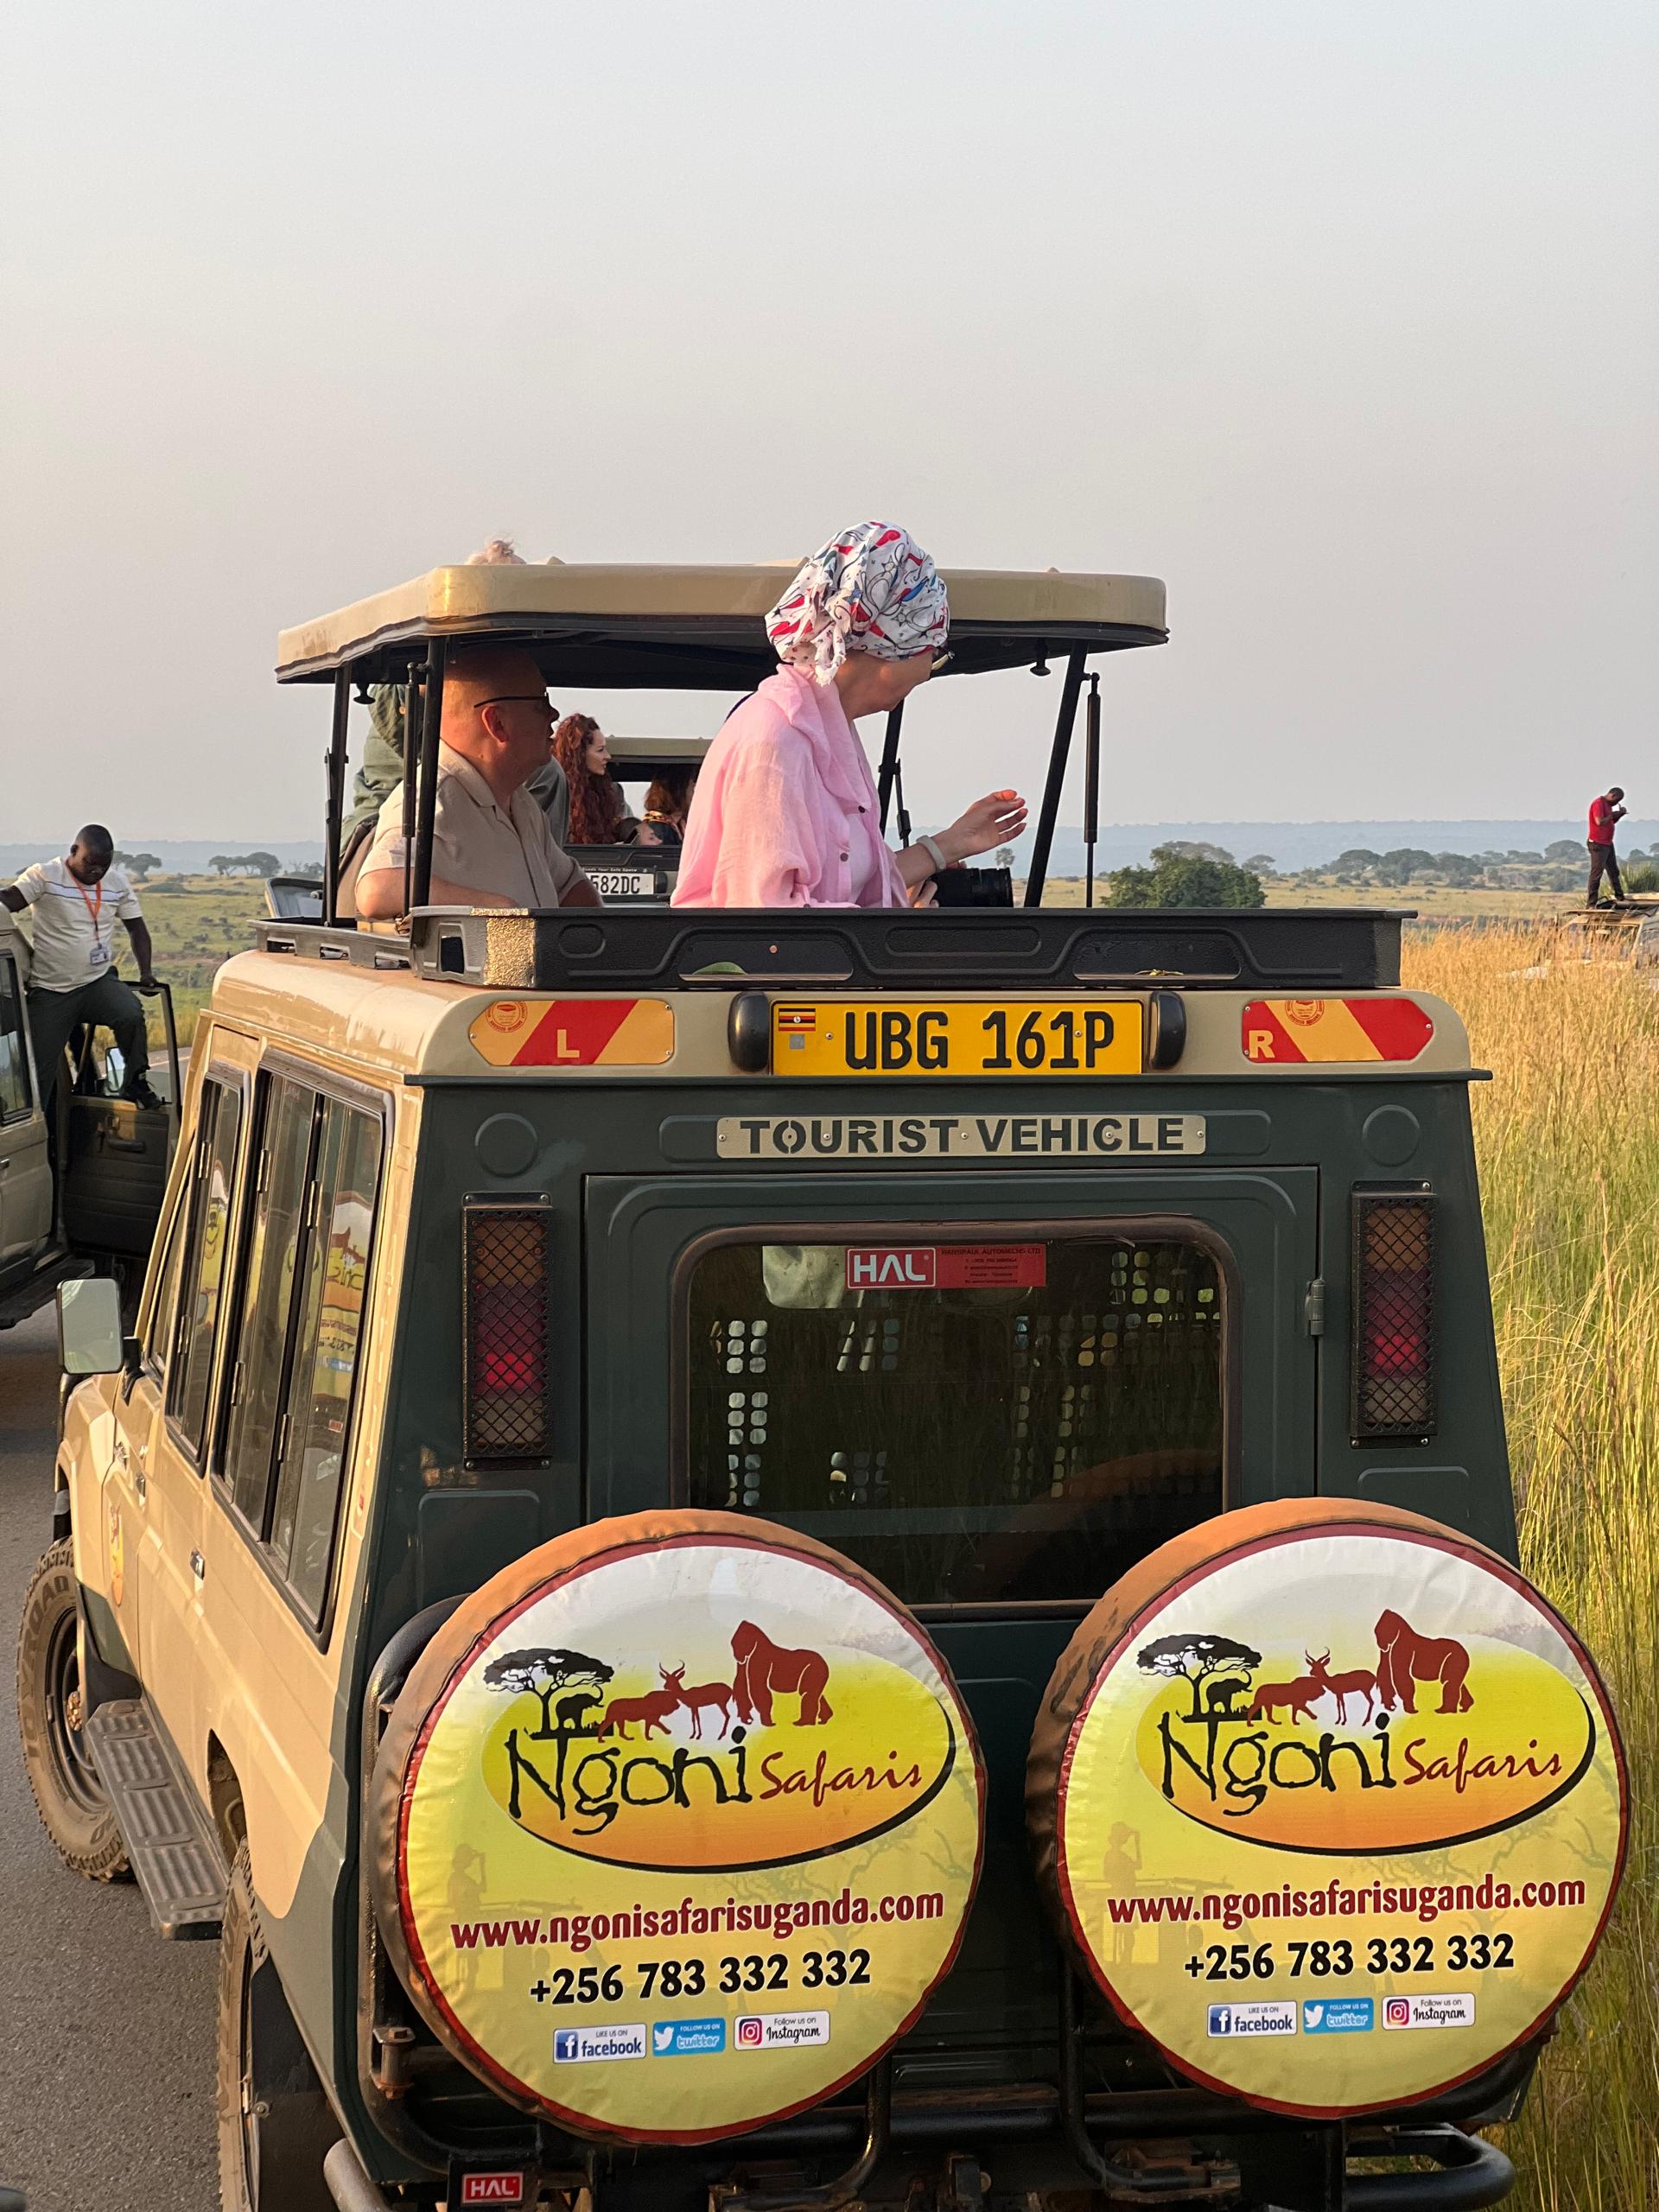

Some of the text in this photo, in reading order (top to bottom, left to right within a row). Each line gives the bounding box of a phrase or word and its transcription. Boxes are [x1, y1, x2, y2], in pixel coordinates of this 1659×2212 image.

[556, 1029, 580, 1058] L
[845, 1010, 1115, 1070] UBG 161P
[1249, 1029, 1274, 1059] R
[740, 1118, 1184, 1154] TOURIST VEHICLE
[854, 1254, 926, 1283] HAL
[1158, 1710, 1562, 1817] Ngoni Safaris
[505, 1726, 922, 1835] Ngoni Safaris
[1106, 1873, 1585, 1930] www.ngonisafarisuganda.com
[450, 1888, 945, 1952] www.ngonisafarisuganda.com
[1185, 1933, 1514, 1980] +256 783 332 332
[531, 1948, 871, 2006] +256 783 332 332
[1235, 2014, 1293, 2031] facebook
[1326, 2013, 1369, 2027] twitter
[1413, 2007, 1466, 2024] Instagram
[582, 2037, 642, 2056] facebook
[677, 2034, 720, 2050] twitter
[766, 2025, 821, 2044] Instagram
[471, 2179, 514, 2197] HAL
